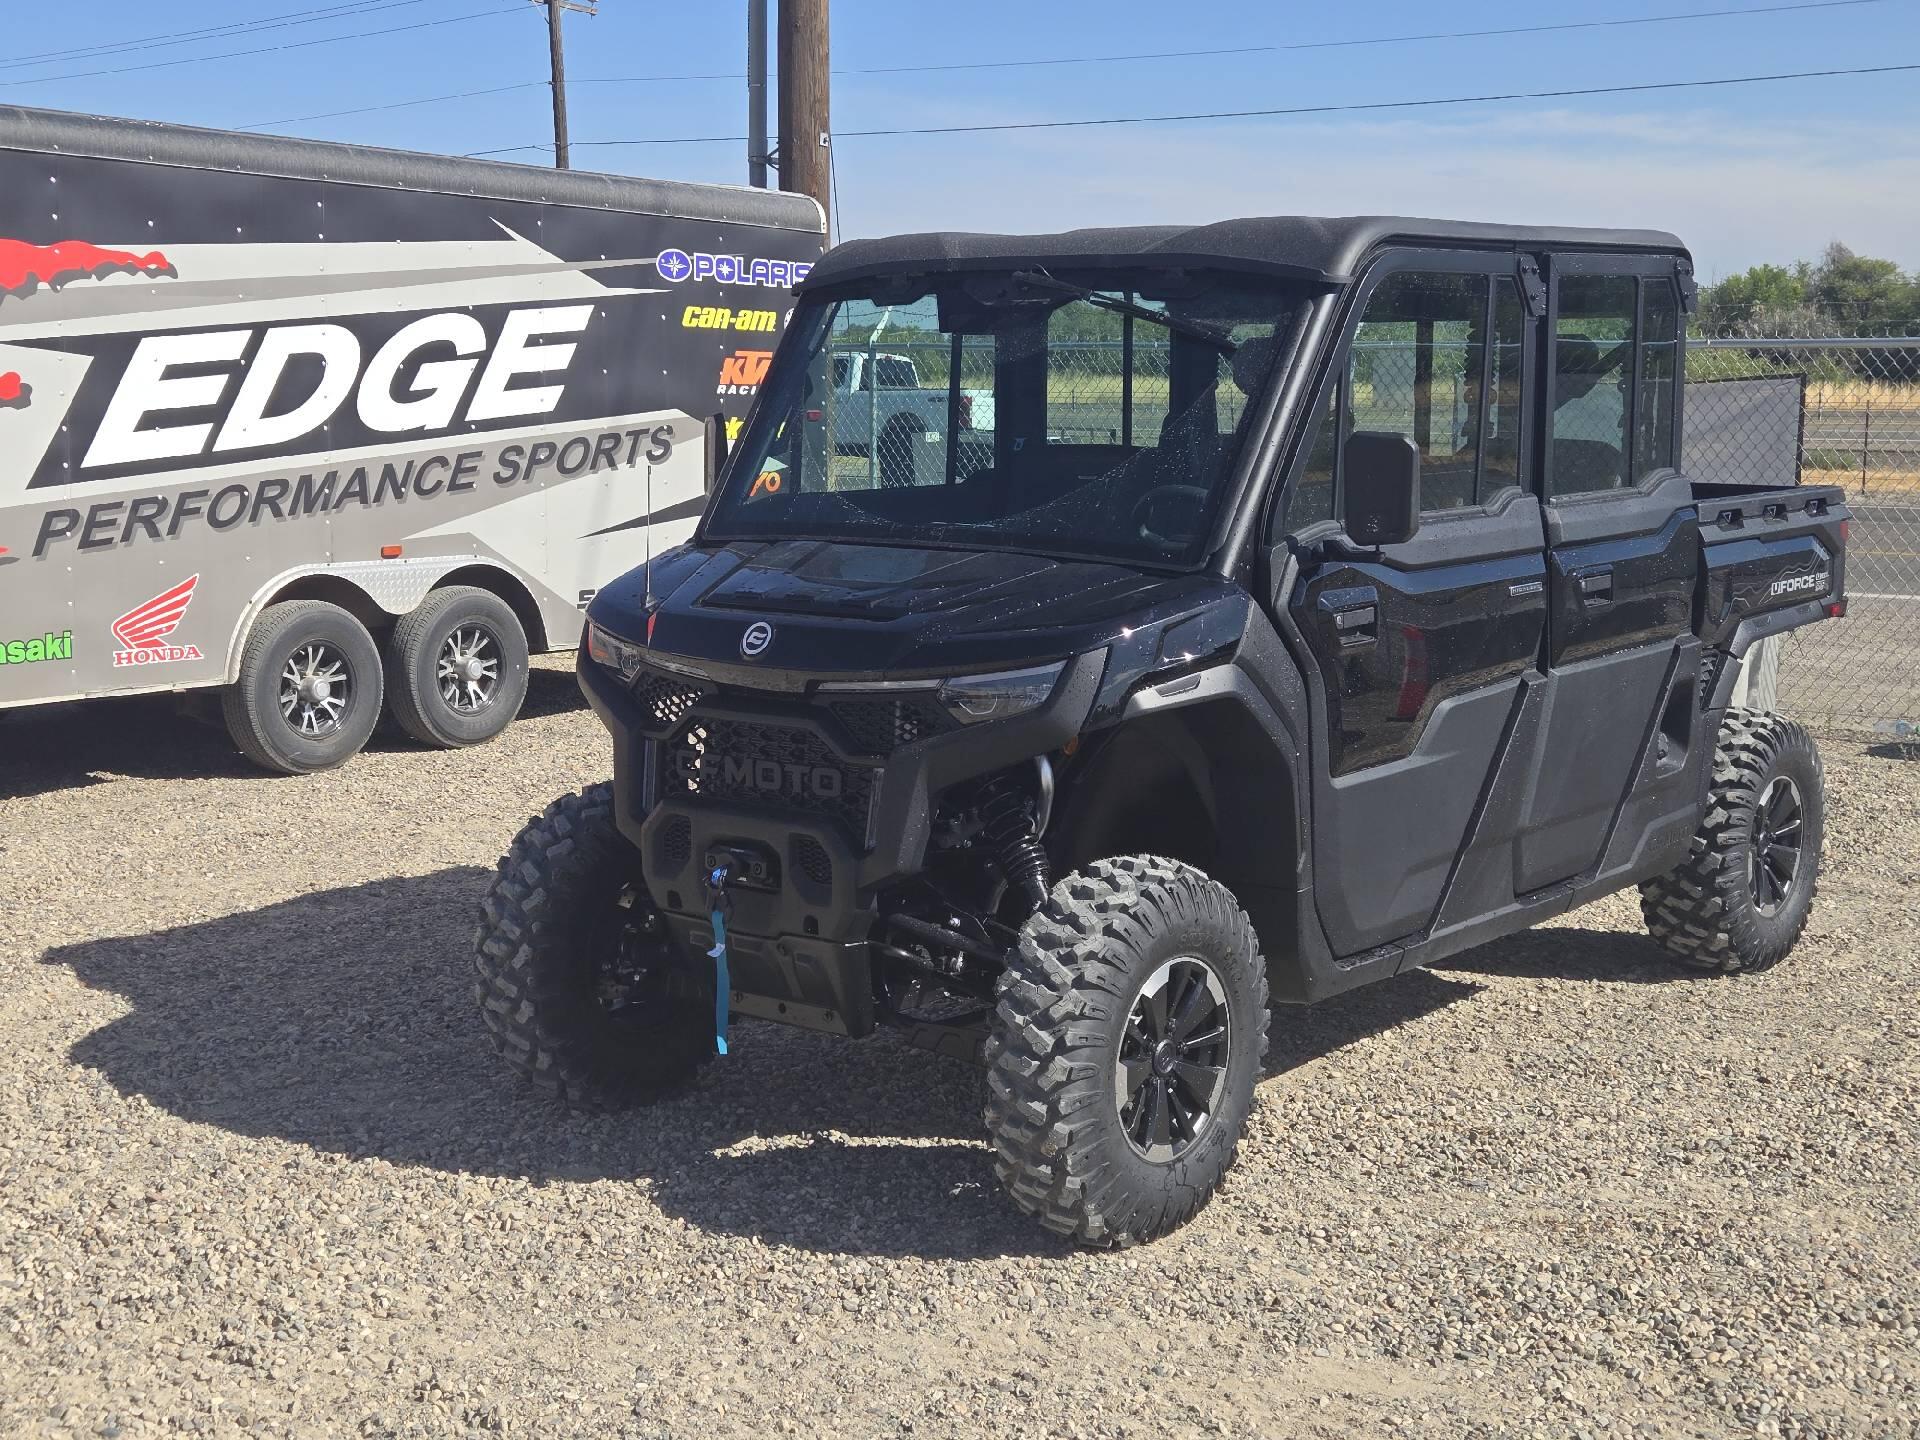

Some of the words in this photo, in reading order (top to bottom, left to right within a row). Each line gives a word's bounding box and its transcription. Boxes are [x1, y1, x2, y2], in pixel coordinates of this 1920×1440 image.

[693, 252, 815, 289] POLARIS
[81, 304, 596, 469] EDGE
[716, 384, 756, 395] RACI
[32, 451, 484, 558] PERFORMANCE
[492, 425, 674, 485] SPORTS
[113, 645, 204, 667] HONDA
[676, 750, 842, 797] CFMOTO
